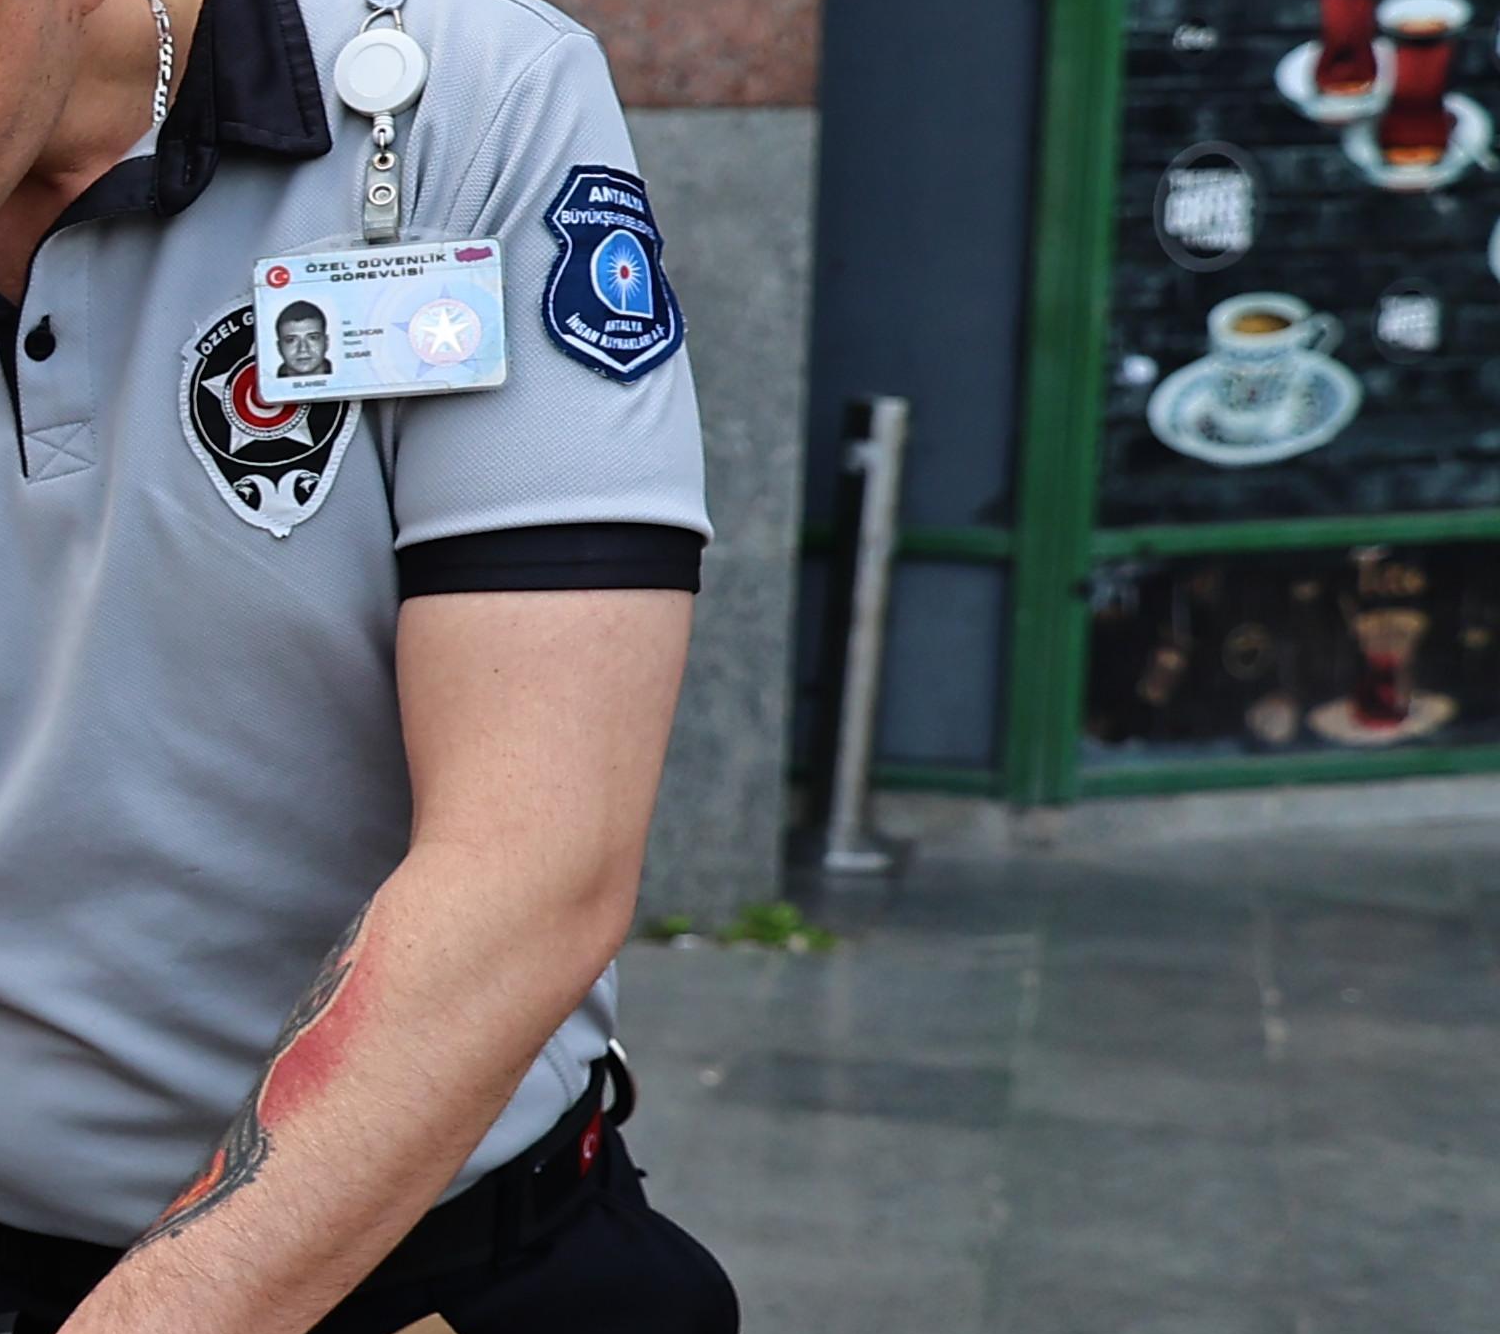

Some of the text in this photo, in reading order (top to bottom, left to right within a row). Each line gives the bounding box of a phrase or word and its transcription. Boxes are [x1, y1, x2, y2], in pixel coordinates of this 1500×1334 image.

[588, 186, 645, 214] ANTALYA
[305, 253, 447, 274] ÖZEL GÜVENLİK
[329, 266, 425, 283] GÖREVLİSİ
[200, 320, 241, 356] ÖZEL
